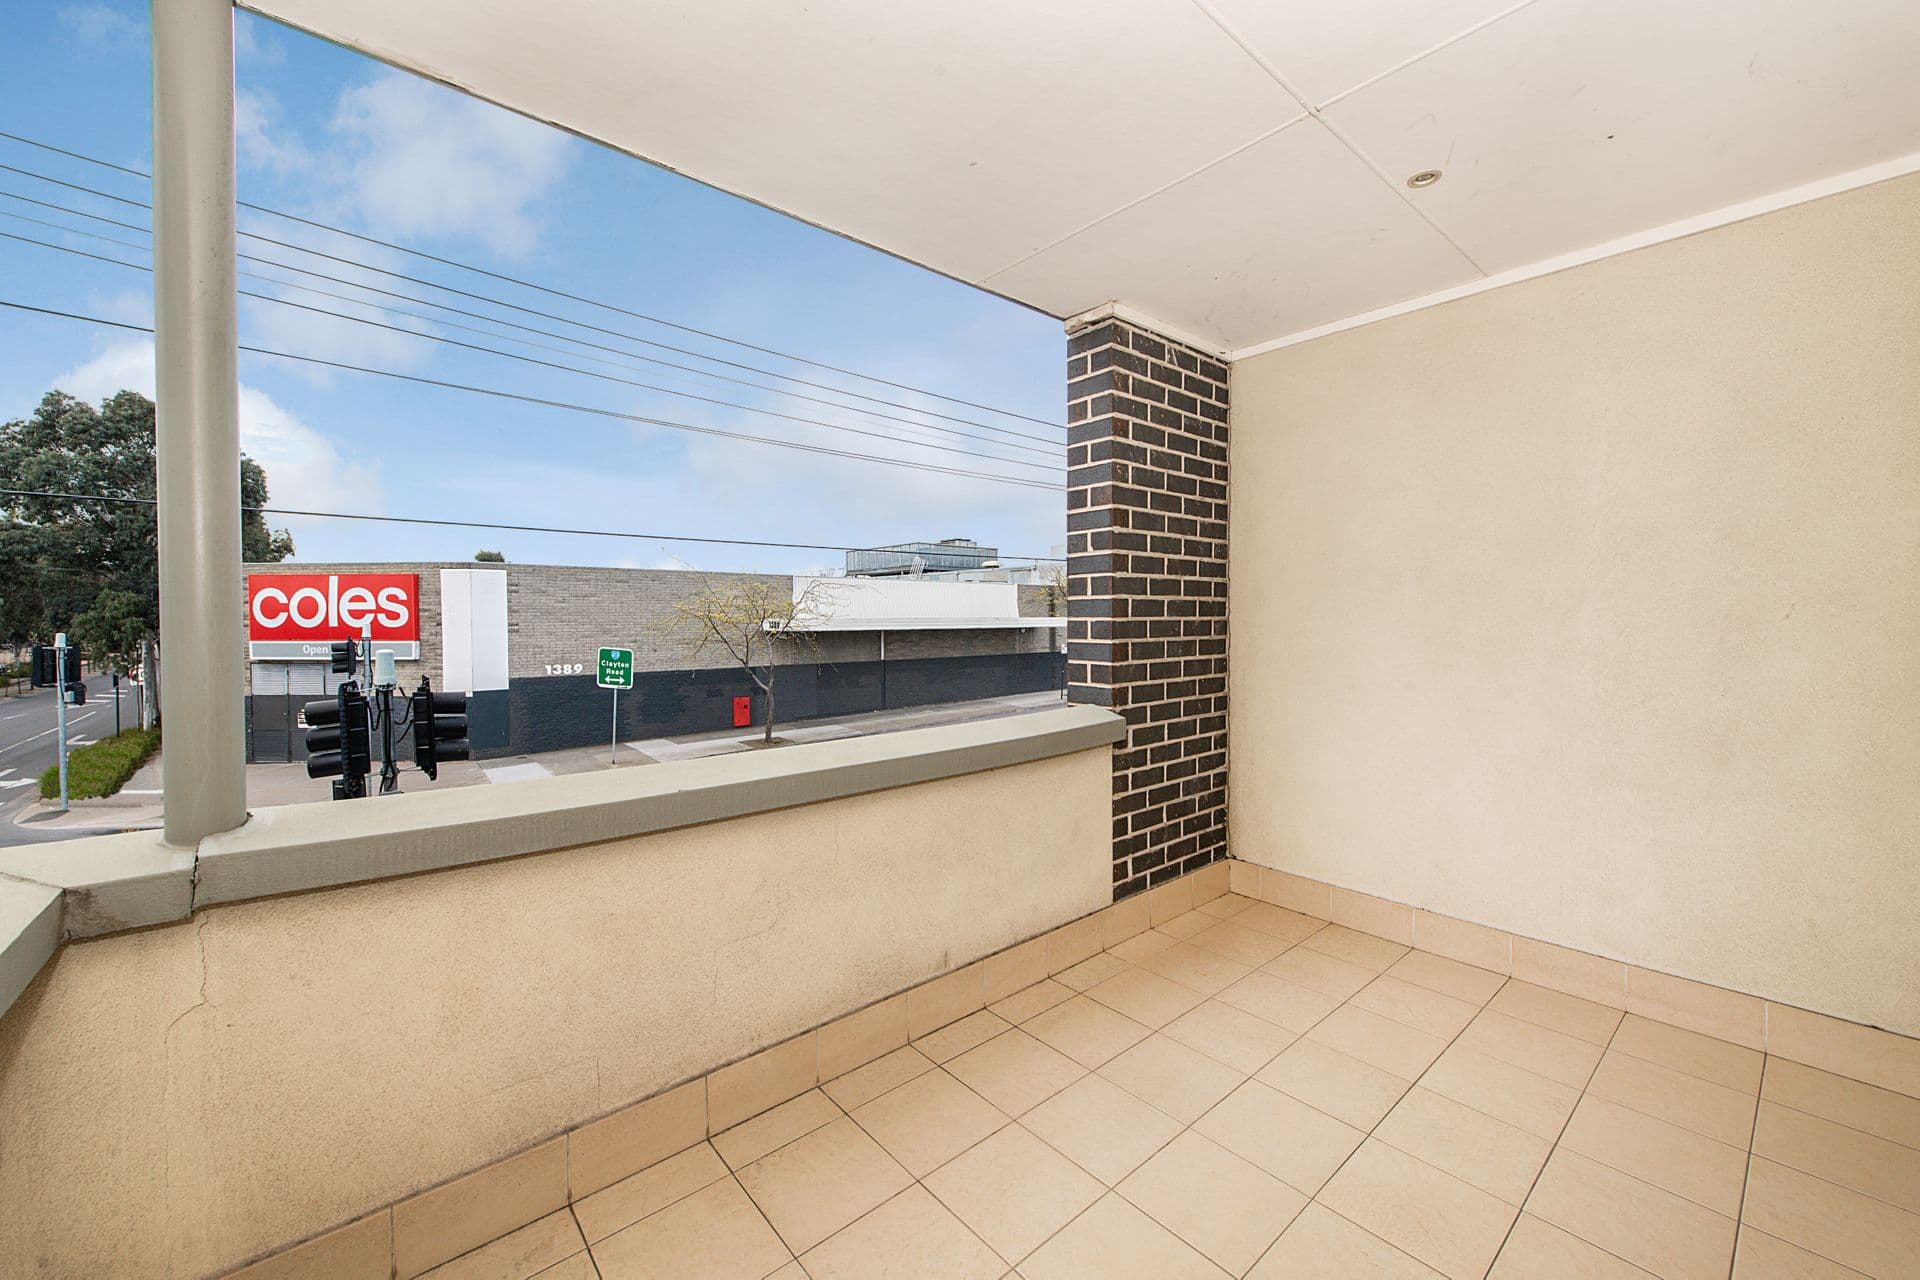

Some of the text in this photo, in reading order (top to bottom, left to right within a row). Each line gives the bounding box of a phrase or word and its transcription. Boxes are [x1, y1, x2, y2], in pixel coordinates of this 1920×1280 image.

[252, 576, 409, 628] coles
[303, 645, 328, 656] Open
[545, 664, 583, 675] 1389
[601, 660, 629, 668] Clayton
